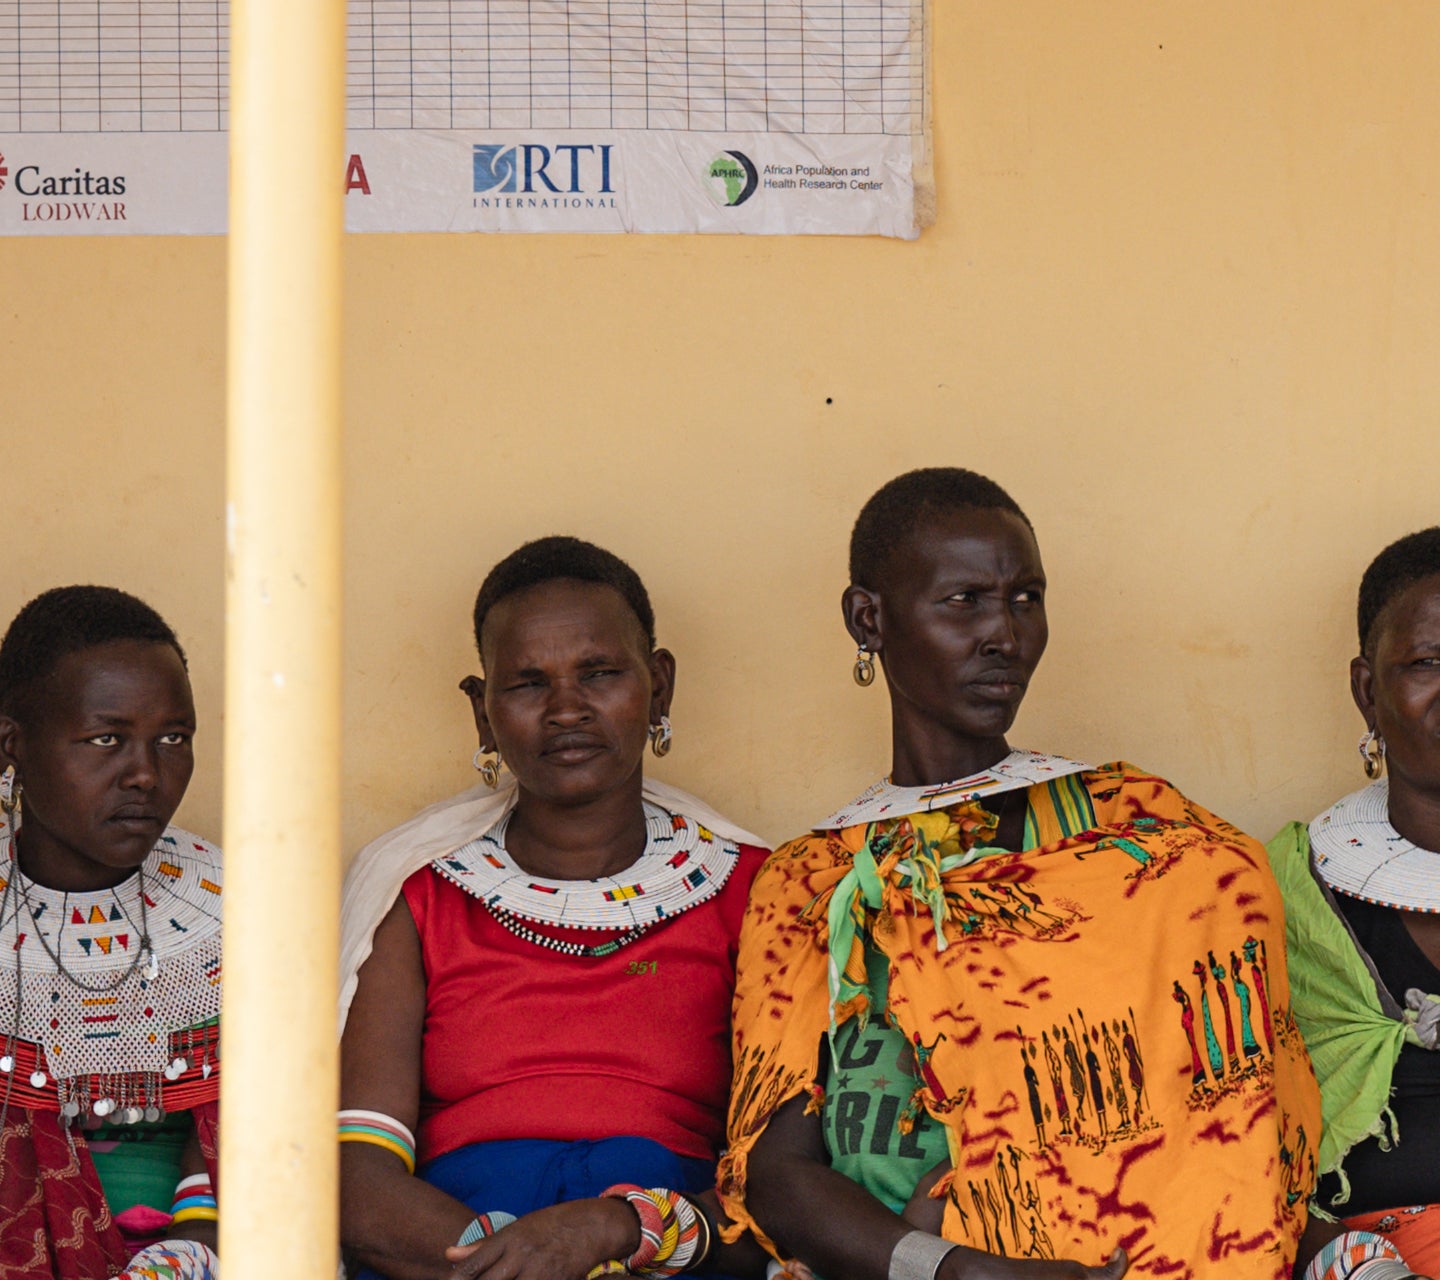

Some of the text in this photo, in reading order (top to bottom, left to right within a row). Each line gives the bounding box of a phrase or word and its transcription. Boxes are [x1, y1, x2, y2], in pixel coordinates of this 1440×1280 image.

[519, 144, 615, 193] RTI
[764, 165, 870, 178] Africa Population and
[14, 165, 127, 197] Caritas
[764, 179, 883, 190] Health Research Center
[473, 198, 617, 208] INTERNATIONAL
[22, 203, 127, 221] LODWAR
